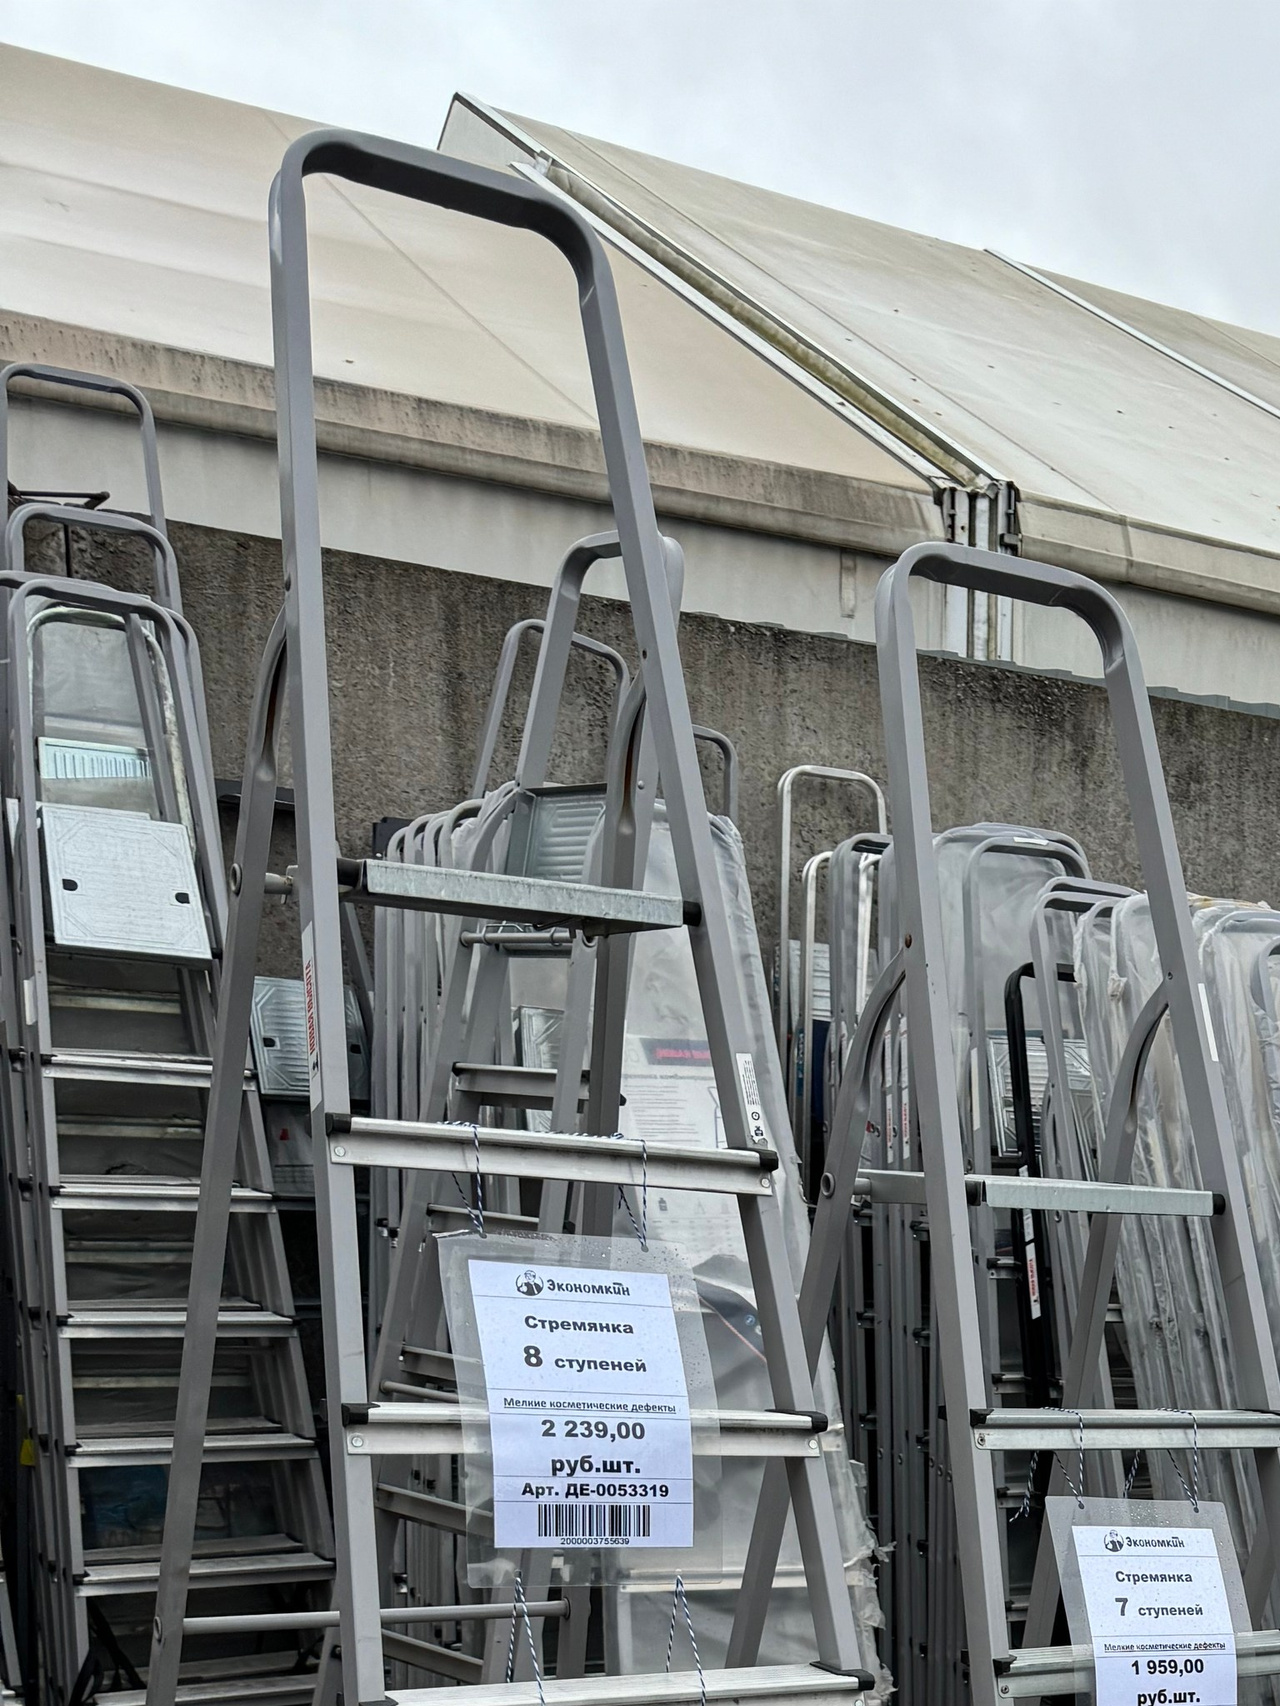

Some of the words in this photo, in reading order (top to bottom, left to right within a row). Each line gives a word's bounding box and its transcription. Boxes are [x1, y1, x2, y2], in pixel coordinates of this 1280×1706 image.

[547, 1279, 630, 1297] Экономкин
[524, 1316, 634, 1335] Стремянка
[523, 1346, 543, 1368] 8
[554, 1355, 647, 1373] ступеней
[504, 1397, 546, 1409] Мелкие
[550, 1399, 628, 1412] косметические
[631, 1402, 676, 1414] дефекты
[542, 1420, 556, 1437] 2
[564, 1421, 645, 1441] 239,00
[551, 1456, 641, 1476] руб.шт.
[522, 1483, 559, 1498] Арт.
[565, 1483, 669, 1499] ДЕ-0053319
[561, 1537, 630, 1545] 2000003755639
[1126, 1536, 1185, 1548] Экономкин
[1116, 1571, 1193, 1585] Стремянка
[1115, 1598, 1128, 1616] 7
[1138, 1603, 1203, 1619] ступеней
[1104, 1643, 1134, 1652] Мелкие
[1136, 1642, 1192, 1651] косметические
[1193, 1642, 1226, 1651] дефекты
[1131, 1661, 1139, 1675] 1
[1146, 1659, 1204, 1676] 959,00
